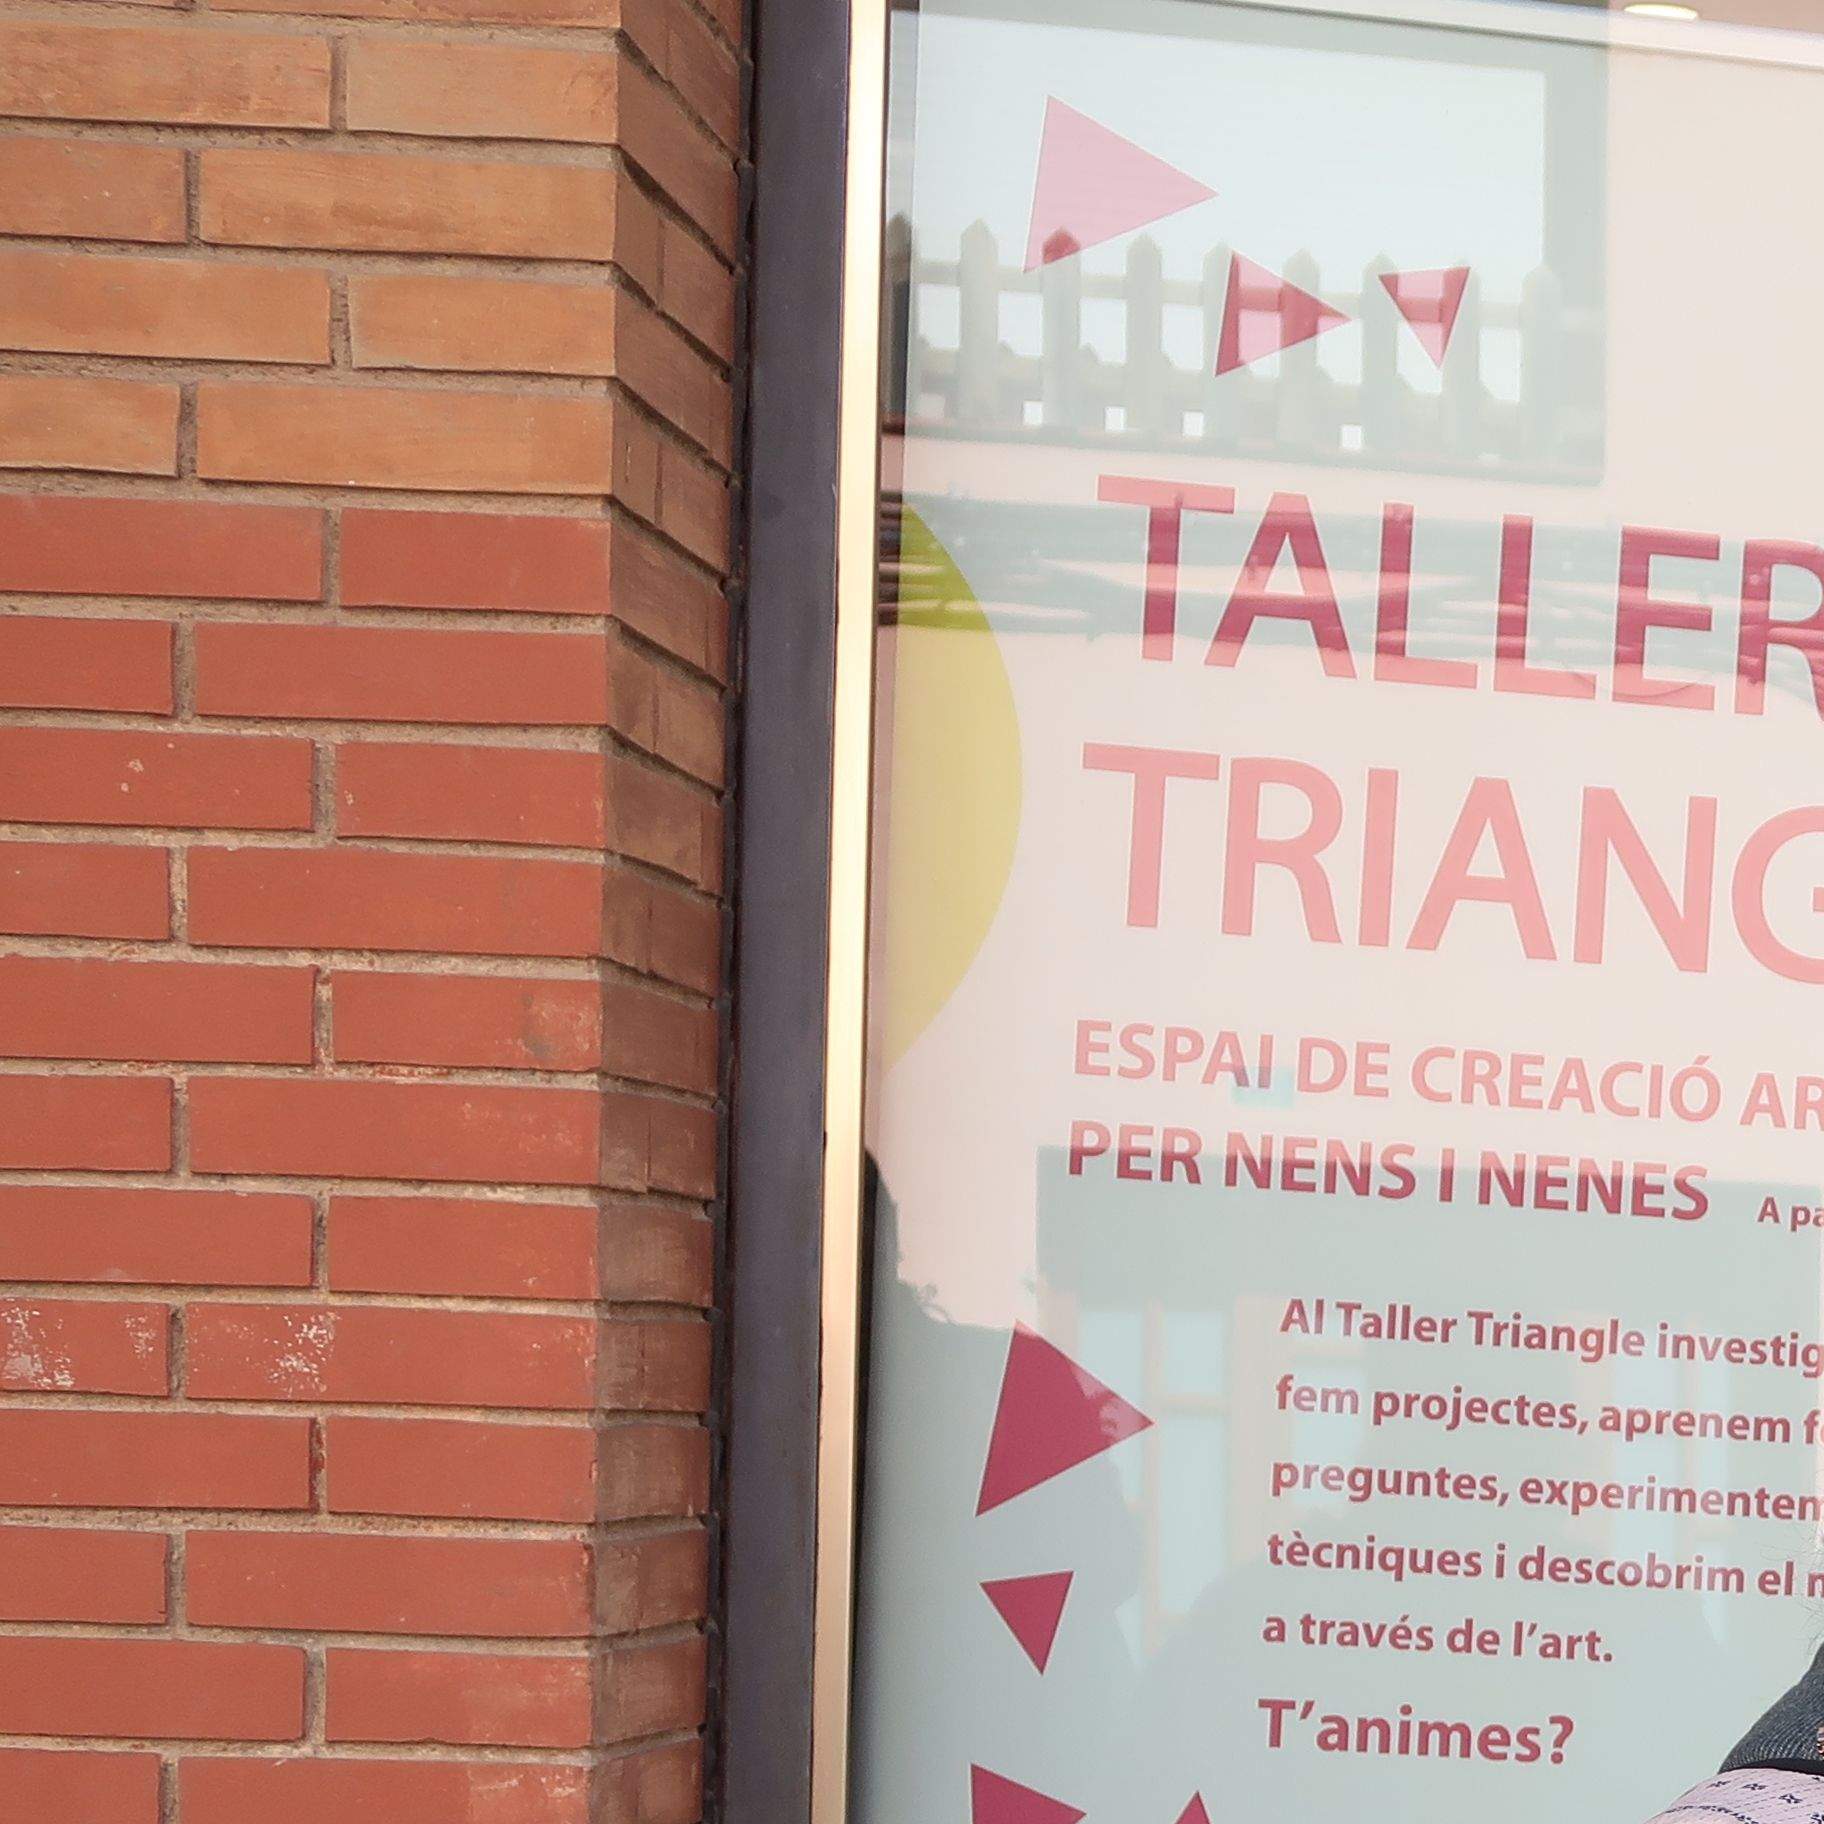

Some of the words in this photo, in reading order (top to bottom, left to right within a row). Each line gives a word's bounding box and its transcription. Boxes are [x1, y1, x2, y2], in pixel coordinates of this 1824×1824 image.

[1073, 1019, 1275, 1092] ESPAI
[1294, 1038, 1392, 1099] DE
[1410, 1049, 1723, 1123] CREACIÓ
[1067, 1120, 1202, 1187] PER
[1221, 1131, 1418, 1200] NENS
[1440, 1146, 1456, 1202] I
[1477, 1150, 1711, 1223] NENES
[1757, 1197, 1781, 1225] A
[1280, 1298, 1325, 1334] Al
[1336, 1302, 1458, 1345] Taller
[1467, 1311, 1645, 1364] Triangle
[1275, 1375, 1360, 1415] fem
[1371, 1385, 1590, 1435] projectes,
[1598, 1407, 1790, 1446] aprenem
[1271, 1460, 1511, 1510] preguntes,
[1267, 1529, 1483, 1583] tècniques
[1494, 1545, 1508, 1579] i
[1517, 1546, 1746, 1593] descobrim
[1757, 1561, 1795, 1597] el
[1262, 1612, 1287, 1644] a
[1298, 1611, 1434, 1653] través
[1446, 1616, 1499, 1655] de
